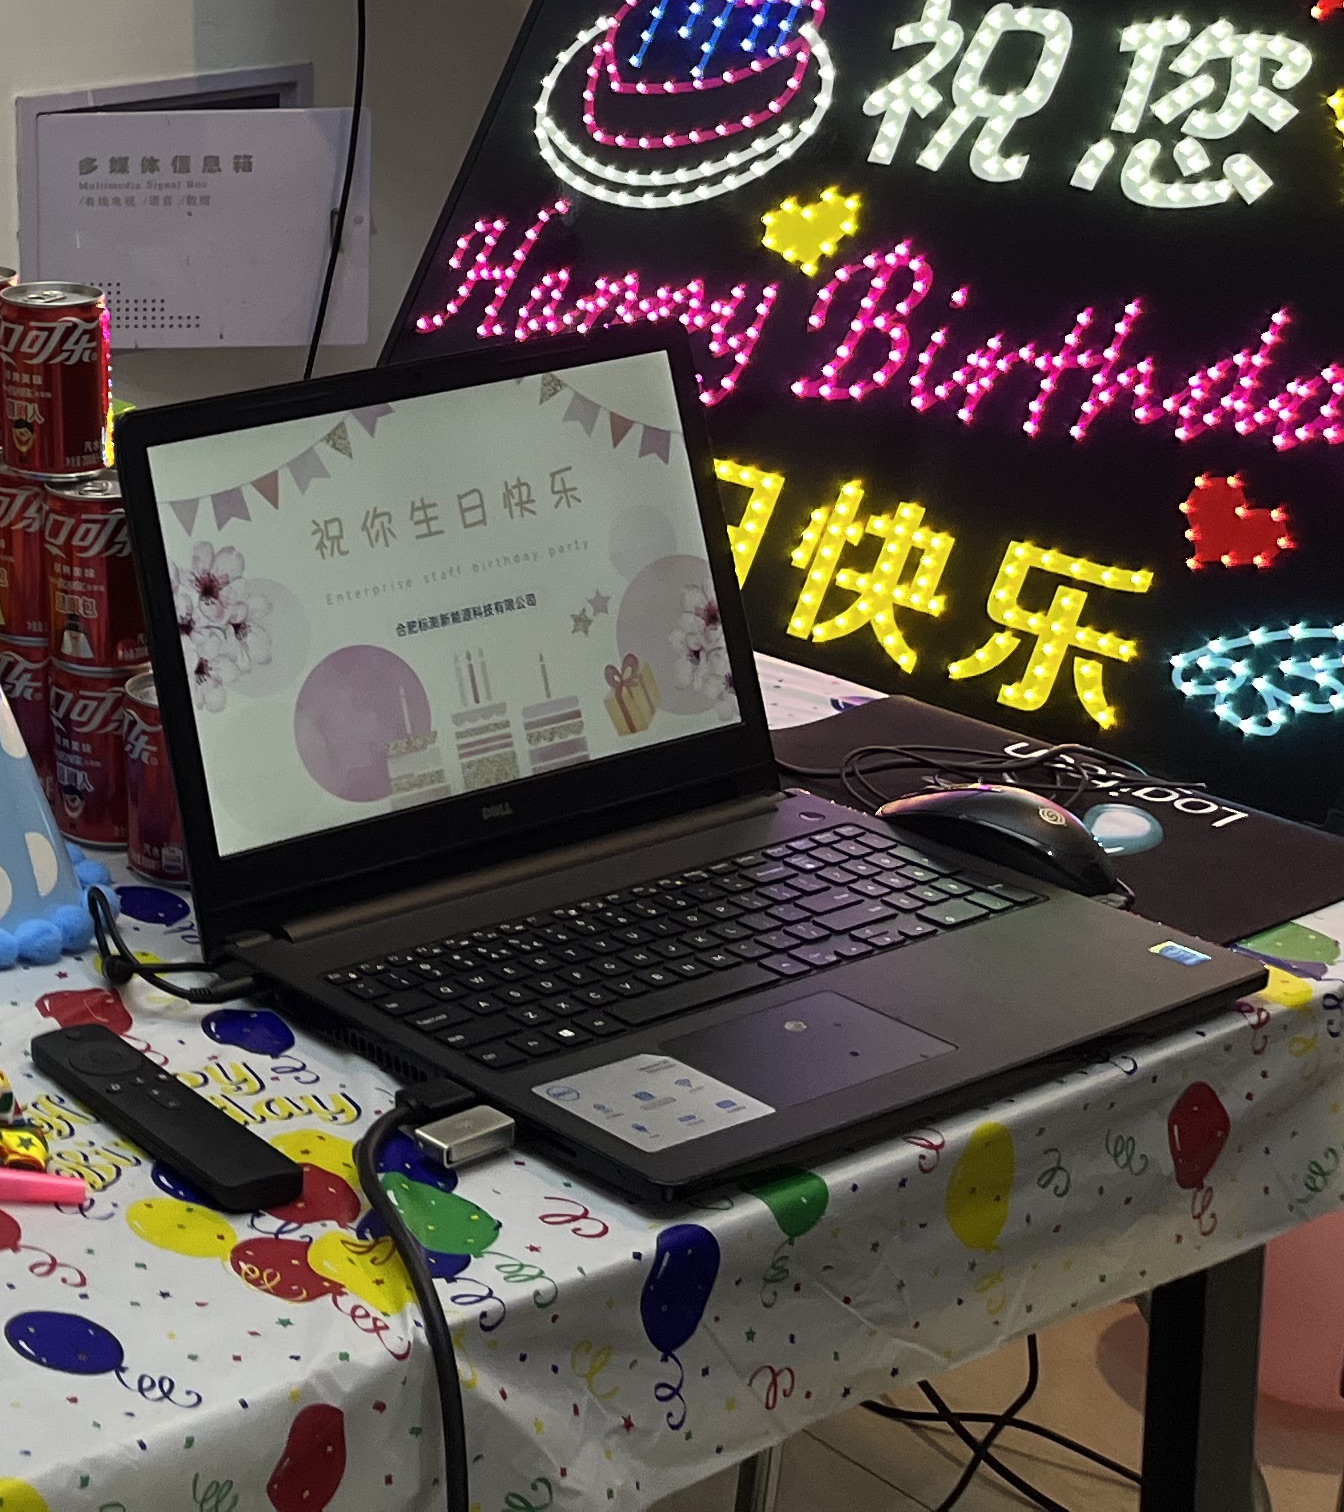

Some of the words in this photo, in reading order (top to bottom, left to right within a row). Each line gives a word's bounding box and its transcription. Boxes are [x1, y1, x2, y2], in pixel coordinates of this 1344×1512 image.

[311, 465, 583, 560] 祝你生日快乐
[325, 577, 414, 607] Enterprise
[422, 564, 465, 586] staff
[471, 548, 540, 574] birthday
[548, 538, 591, 560] party
